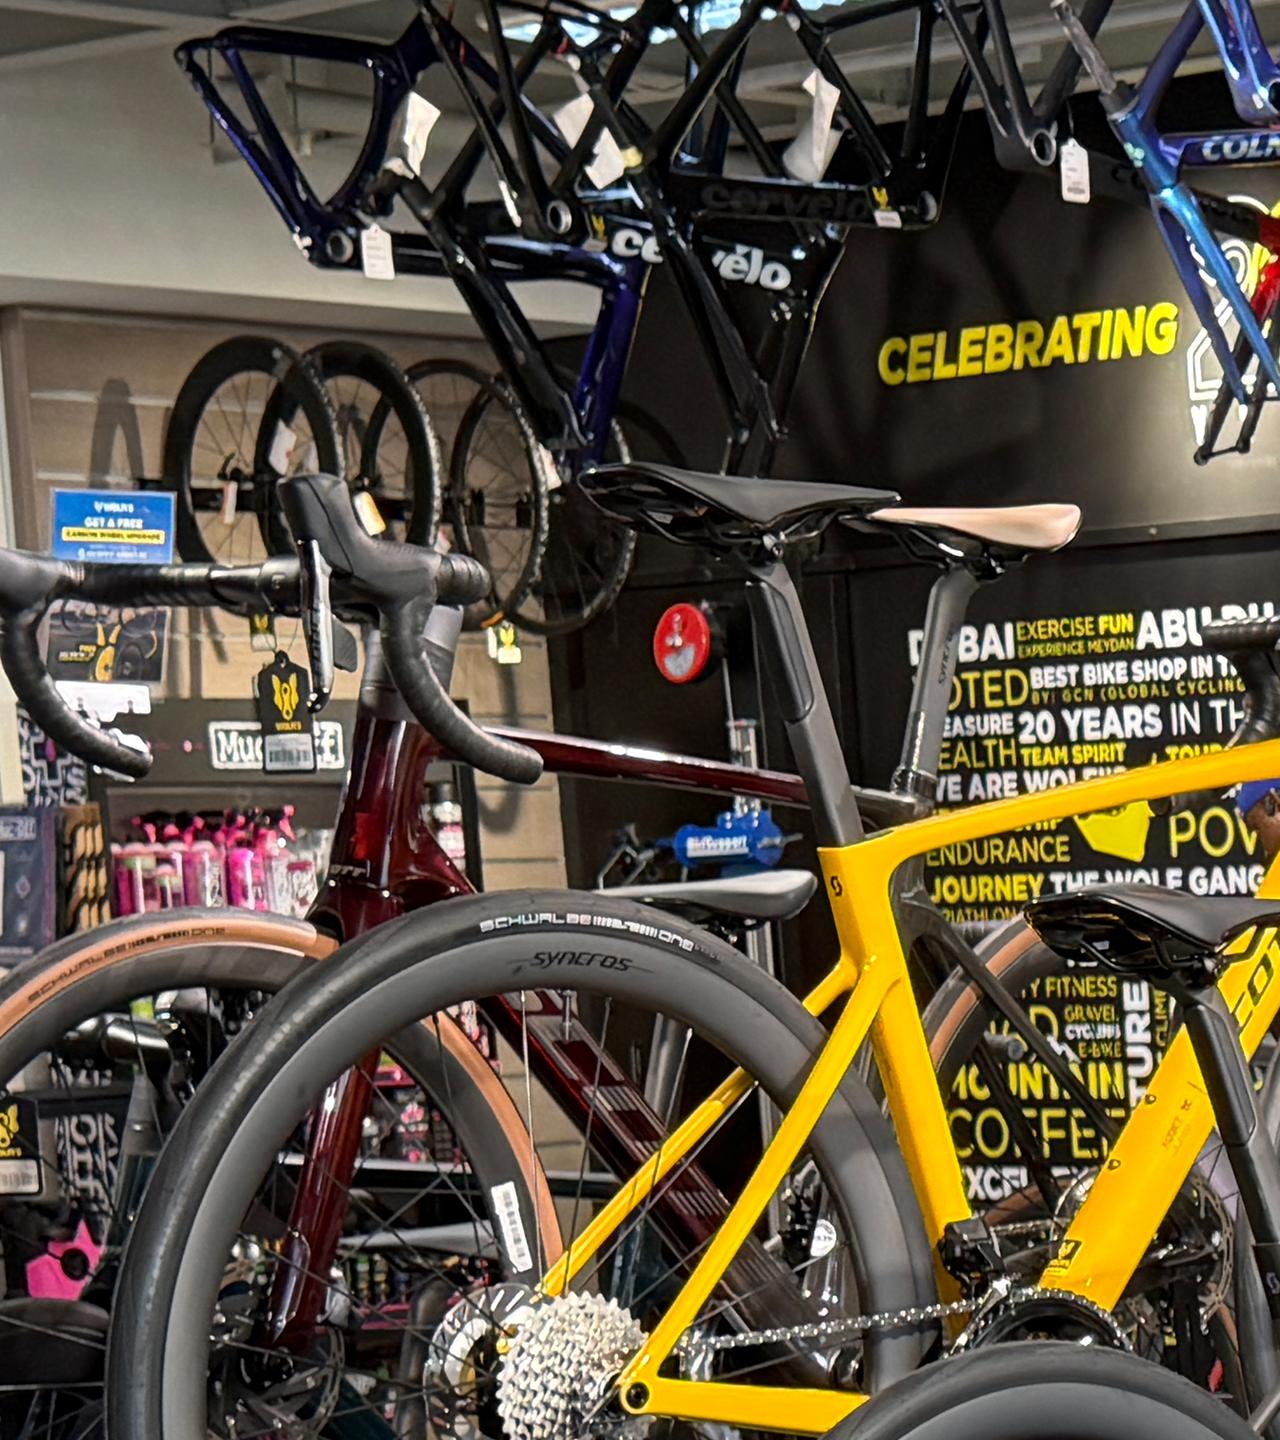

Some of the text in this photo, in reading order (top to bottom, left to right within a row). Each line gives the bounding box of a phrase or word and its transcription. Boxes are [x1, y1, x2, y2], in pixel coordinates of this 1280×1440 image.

[878, 302, 1179, 386] CELEBRATING
[1017, 614, 1134, 641] EXERCISE FUN
[1018, 641, 1086, 660] EXPERIENCE
[1030, 663, 1078, 690] BEST
[1083, 660, 1128, 686] BIKE
[1132, 656, 1183, 684] SHOP
[1191, 653, 1214, 679] IN
[1176, 676, 1246, 699] CYCLING
[943, 712, 1014, 738] EASURE
[1019, 698, 1246, 744] 20 YEARS IN TH
[938, 737, 1017, 771] EALTH
[1021, 742, 1127, 767] TEAM SPIRIT
[969, 773, 1018, 799] ARE
[927, 835, 1071, 867] ENDURANCE
[930, 872, 1045, 904] JOURNEY
[1188, 862, 1264, 896] GANG
[479, 912, 592, 933] SCHWALBE
[1046, 975, 1117, 998] FITNESS
[1064, 1003, 1119, 1023] GRAVEL
